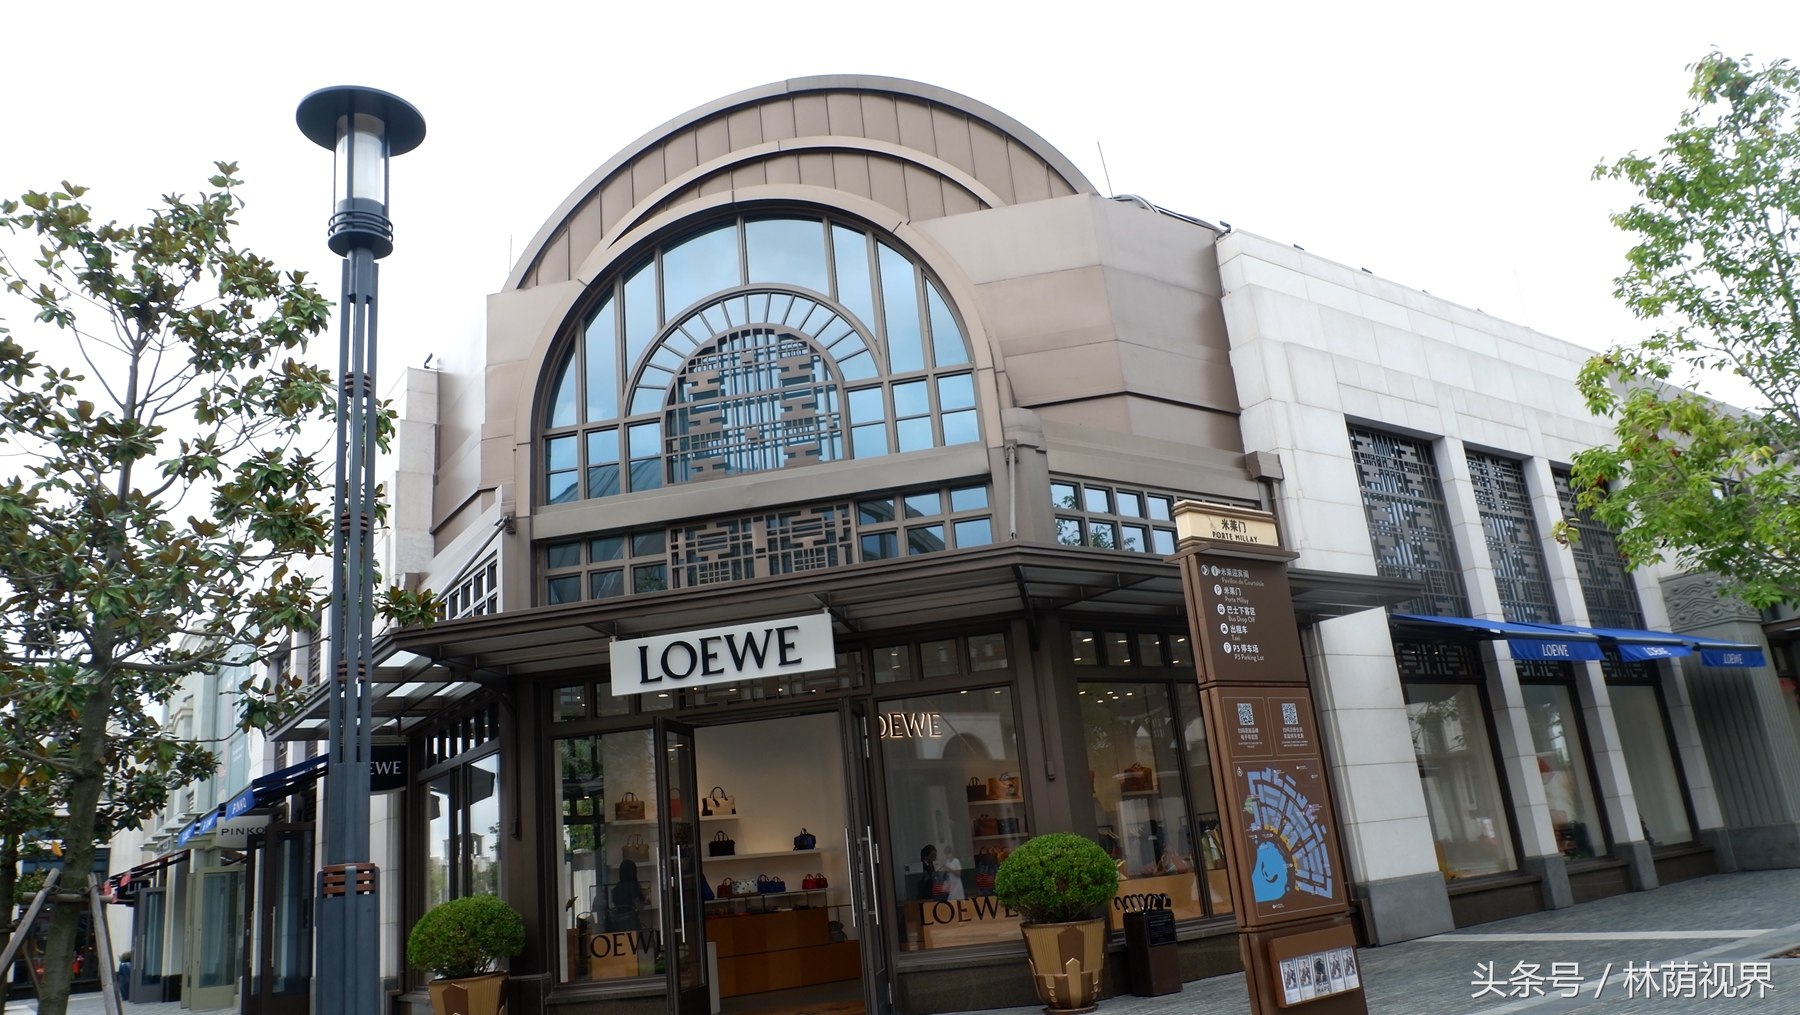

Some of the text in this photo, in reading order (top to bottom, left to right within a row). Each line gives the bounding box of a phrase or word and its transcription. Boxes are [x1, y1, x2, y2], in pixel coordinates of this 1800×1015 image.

[1221, 518, 1247, 533] 米莱门
[1212, 531, 1258, 543] PORTE MILLAY
[1226, 605, 1256, 616] 巴士下客区
[1230, 625, 1248, 634] 出租车
[637, 625, 802, 684] LOEWE
[1542, 644, 1570, 657] LOEWE
[1241, 654, 1257, 663] Parking
[1724, 653, 1744, 665] LOEWE
[221, 826, 265, 836] PINKO
